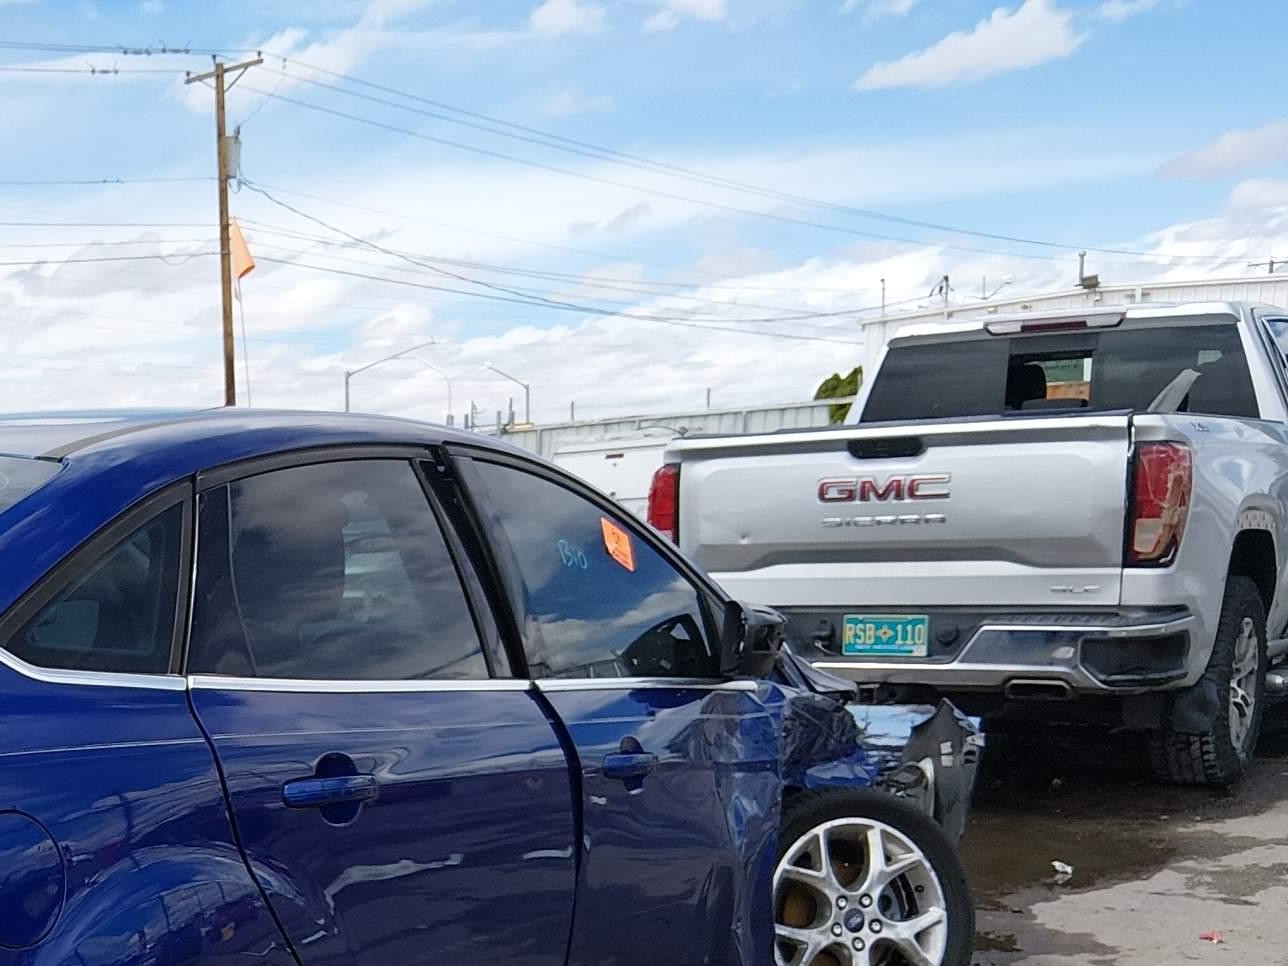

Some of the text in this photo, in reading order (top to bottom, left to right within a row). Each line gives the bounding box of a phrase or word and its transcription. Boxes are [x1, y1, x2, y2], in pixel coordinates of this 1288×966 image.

[817, 473, 952, 504] GMC
[845, 623, 925, 645] RSB 110
